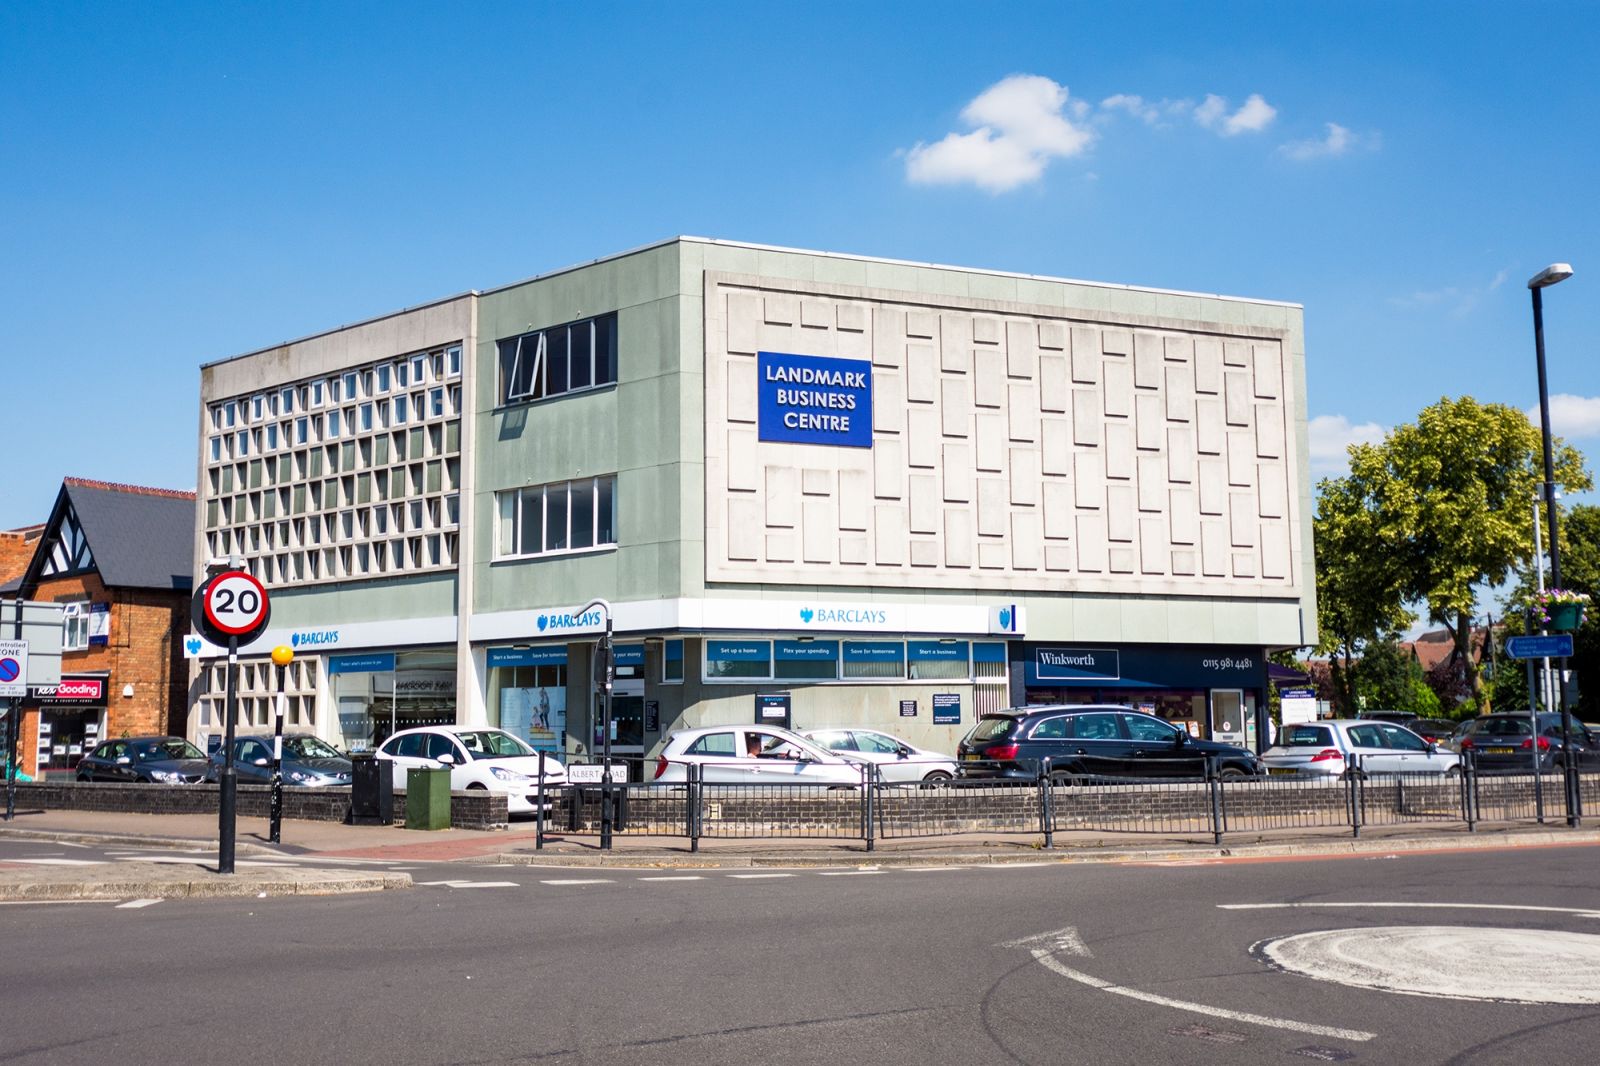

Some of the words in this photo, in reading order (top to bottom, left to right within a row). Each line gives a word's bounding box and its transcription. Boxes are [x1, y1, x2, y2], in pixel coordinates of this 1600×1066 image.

[766, 366, 866, 388] LANDMARK
[777, 389, 856, 410] BUSINESS
[784, 412, 849, 431] CENTRE
[215, 588, 258, 614] 20
[549, 612, 601, 628] BARCLAYS
[817, 608, 886, 623] BARCLAYS
[300, 631, 339, 644] BARCLAYS
[1040, 652, 1095, 666] Winkworth
[1203, 659, 1219, 670] 0115
[1220, 657, 1233, 670] 981
[1235, 657, 1252, 670] 4481
[58, 684, 98, 696] Gooding
[571, 770, 600, 778] ALBERT
